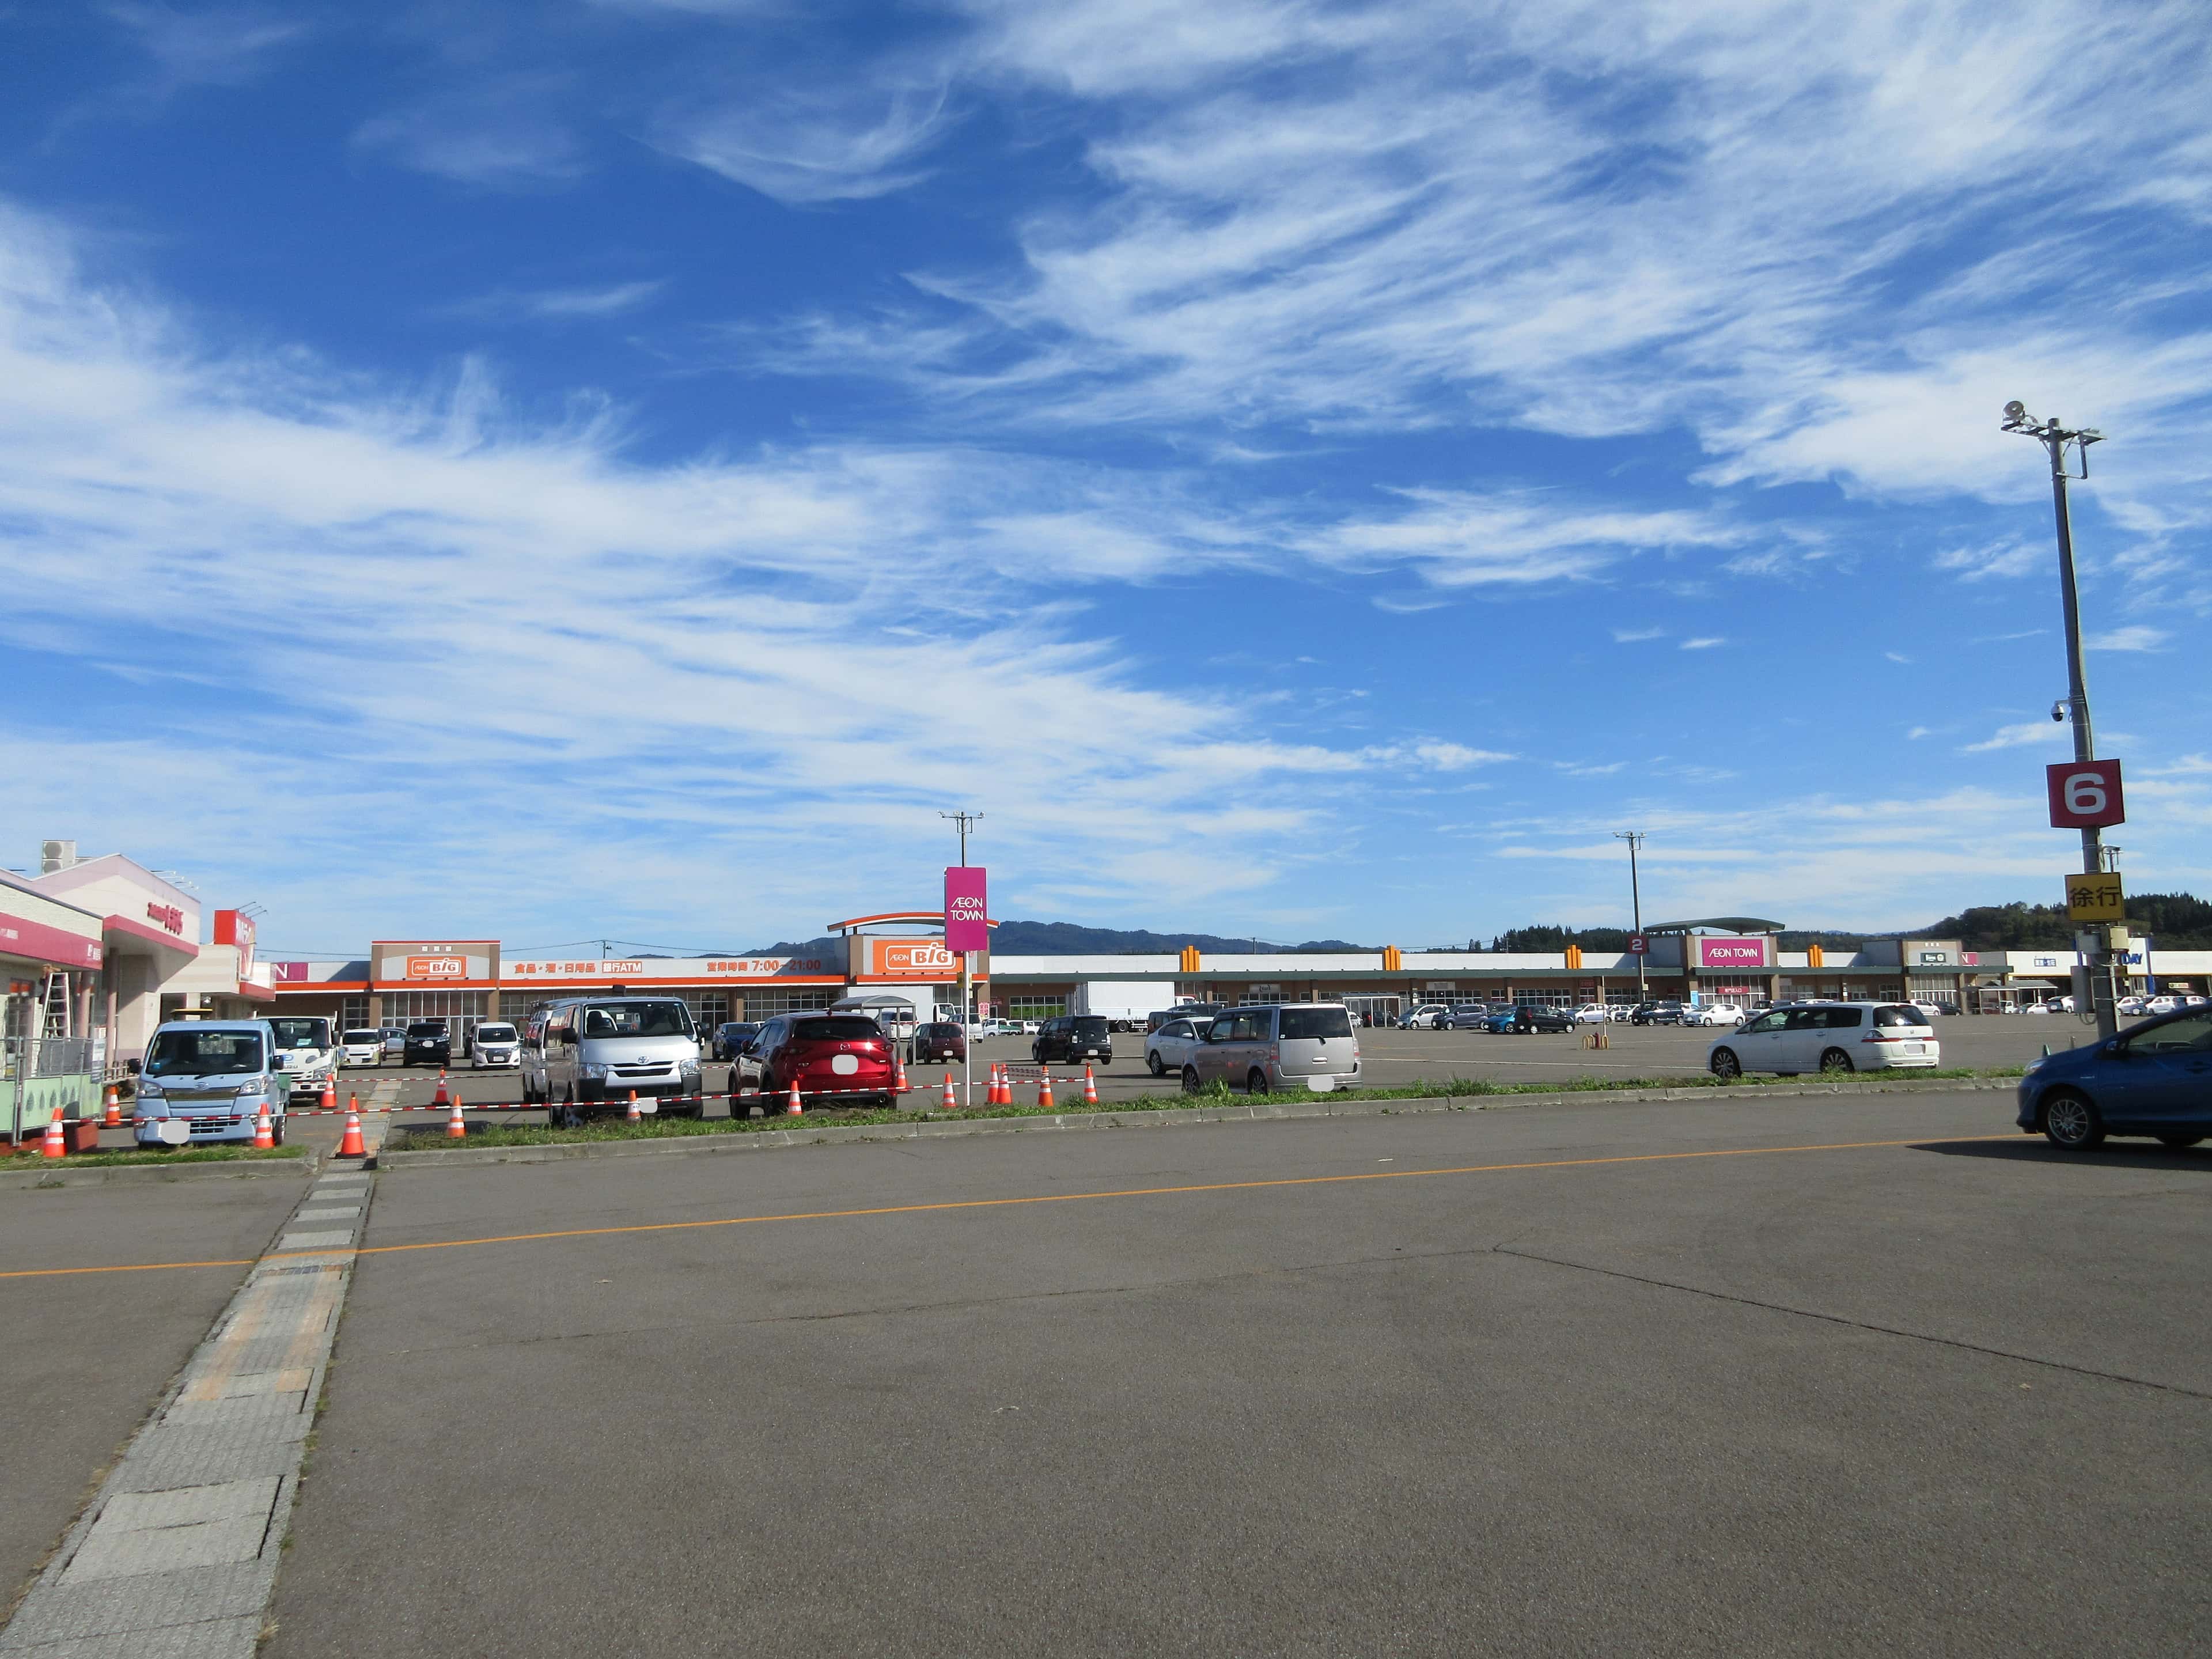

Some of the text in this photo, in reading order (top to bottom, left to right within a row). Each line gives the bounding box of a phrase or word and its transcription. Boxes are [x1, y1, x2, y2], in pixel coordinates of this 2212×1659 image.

[2065, 772, 2106, 815] 6
[2070, 886, 2120, 908] 徐行
[950, 910, 984, 921] TOWN
[1632, 938, 1642, 950] 2
[1733, 948, 1758, 958] TOWN
